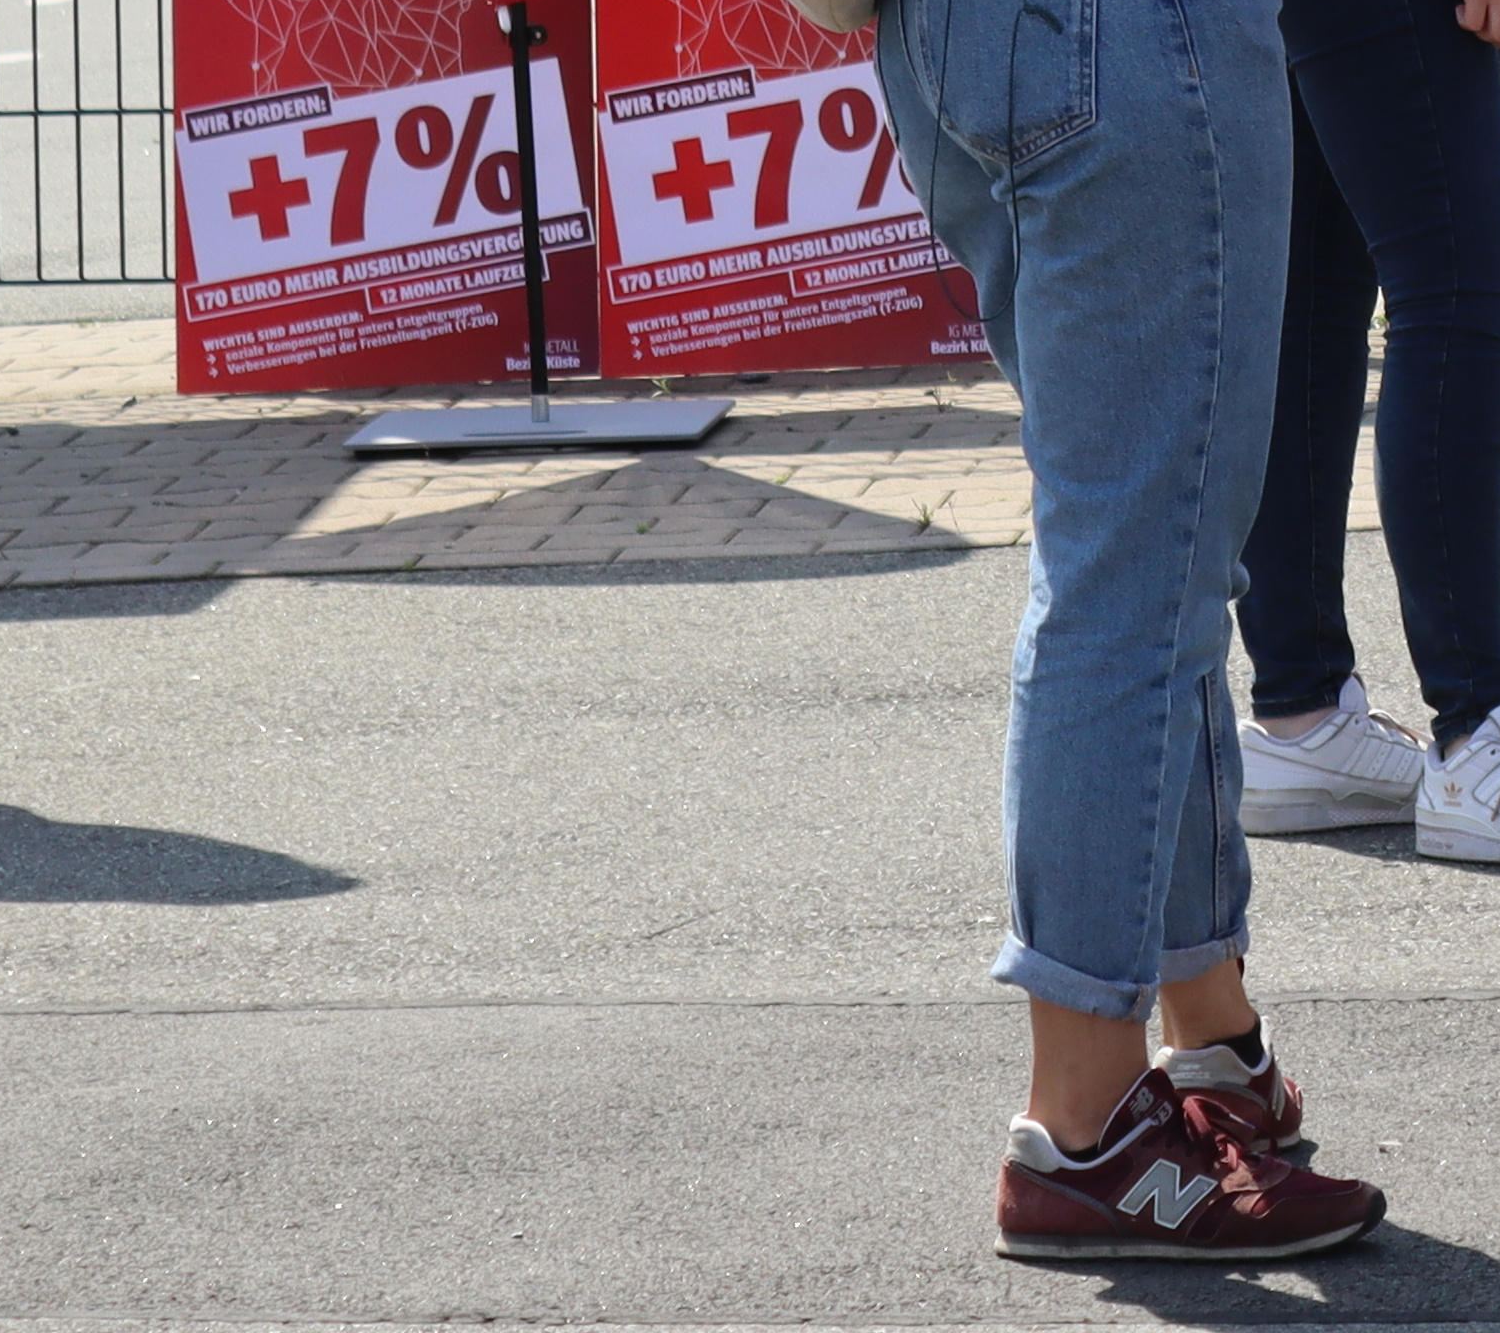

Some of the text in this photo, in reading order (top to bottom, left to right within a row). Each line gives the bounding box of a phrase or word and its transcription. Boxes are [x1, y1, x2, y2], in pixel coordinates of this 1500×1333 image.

[189, 94, 328, 137] WIR FORDERN:
[612, 77, 751, 119] WIR FORDERN:
[618, 219, 931, 294] 170 EURO MEHR AUSBILDUNGSVER
[803, 247, 950, 288] 12 MONATE LAUFZEI
[194, 289, 228, 312] 170
[230, 281, 282, 305] EURO
[285, 267, 340, 295] MEHR
[379, 262, 526, 305] 12 MONATE LAUFZEI
[203, 311, 364, 352] WICHTIG SIND AUSSERDEM:
[224, 304, 483, 362] soziale Komponente für untere Entgeltgruppen
[626, 294, 789, 334] WICHTIG SIND AUSSERDEM:
[649, 286, 908, 345] soziale Komponente für untere Entgeltgruppen
[650, 294, 924, 358] Verbesserungen bei der Freistellungszeit (T-ZUG)
[947, 325, 960, 338] IG
[226, 312, 499, 375] Verbesserungen bei der Freistellungszeit (T-ZUG)
[546, 355, 581, 369] Küste
[930, 340, 988, 355] Bezirk Kü
